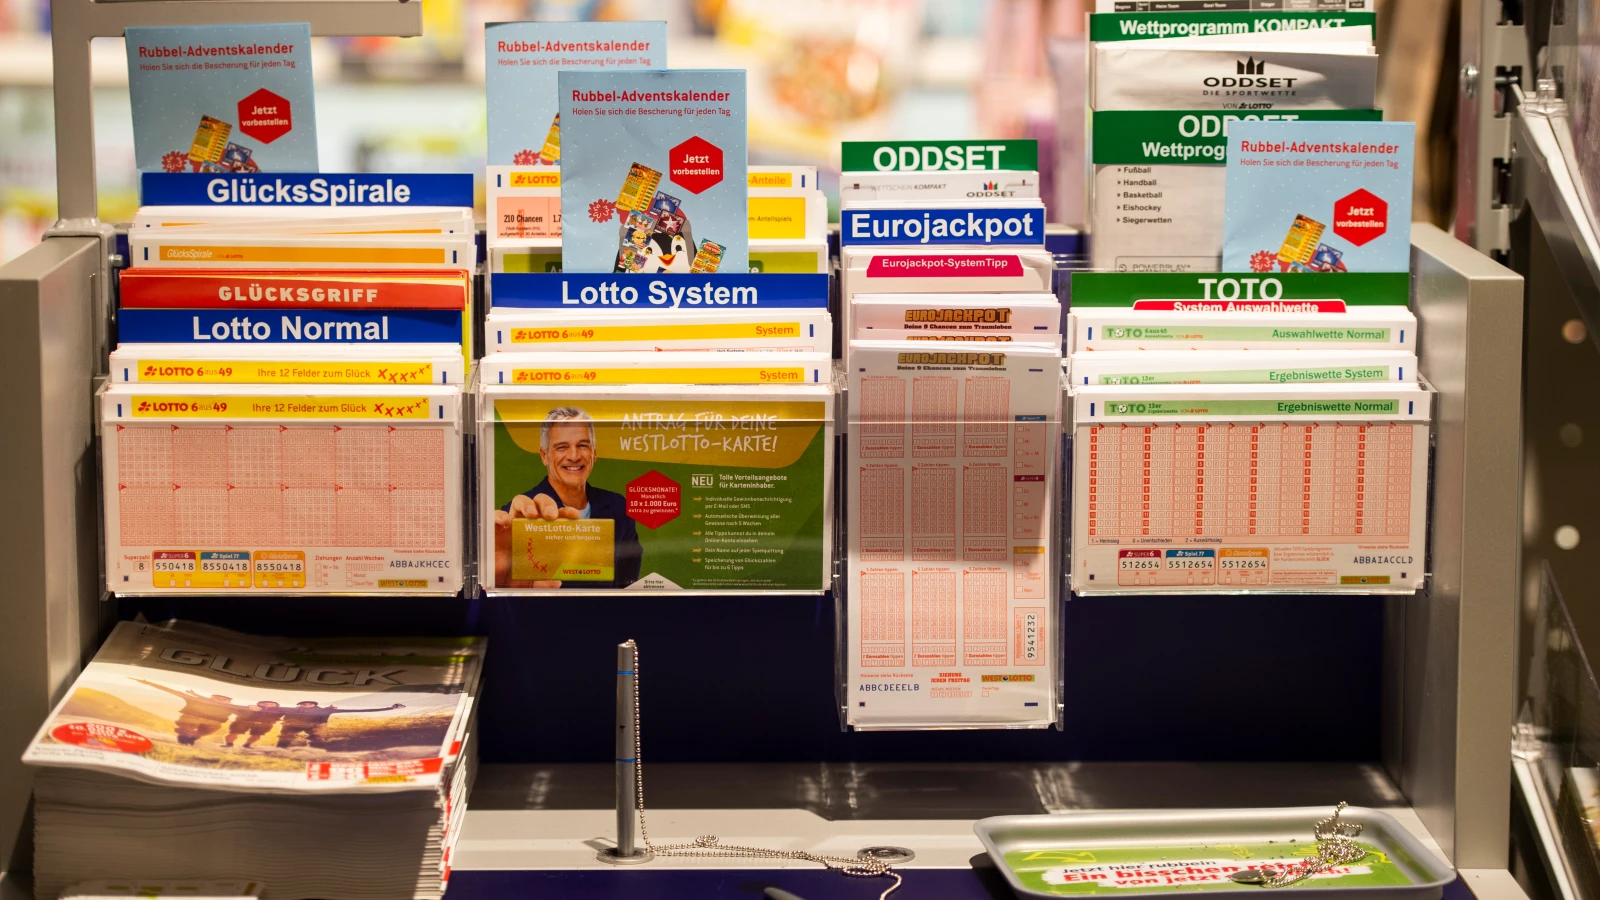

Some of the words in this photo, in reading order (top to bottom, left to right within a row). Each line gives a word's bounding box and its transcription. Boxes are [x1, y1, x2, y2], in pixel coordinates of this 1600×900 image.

[1120, 20, 1248, 38] Wettprogramm
[1254, 19, 1346, 33] KOMPAKT
[138, 43, 294, 58] Rubbel-Adventskalender
[498, 40, 651, 53] Rubbel-Adventskalender
[498, 58, 519, 66] Holen
[520, 58, 531, 66] Sie
[533, 58, 548, 66] sich
[549, 58, 561, 66] die
[562, 58, 605, 67] Bescherung
[606, 57, 616, 66] für
[618, 58, 638, 66] jeden
[639, 57, 651, 66] Tag
[1204, 77, 1298, 88] ODDSET
[572, 90, 730, 102] Rubbel-Adventskalender
[252, 106, 278, 115] Jetzt
[572, 108, 594, 116] Holen
[595, 108, 607, 116] Sie
[608, 108, 624, 116] sich
[638, 108, 683, 117] Bescherung
[696, 108, 716, 117] jeden
[718, 108, 731, 117] Tag
[242, 118, 289, 127] vorbestellen
[1142, 142, 1227, 161] Wettprog
[1241, 141, 1399, 154] Rubbel-Adventskalender
[683, 155, 710, 164] Jetzt
[873, 145, 1006, 172] ODDSET
[1306, 160, 1350, 169] Bescherung
[1364, 160, 1384, 169] jeden
[1386, 160, 1399, 170] Tag
[528, 176, 558, 184] LOTTO
[748, 176, 786, 185] -Anteile
[207, 178, 411, 206] GlücksSpirale
[1123, 204, 1162, 212] Eishockey
[1347, 207, 1374, 217] Jetzt
[504, 215, 514, 223] 210
[517, 215, 543, 223] Chancen
[1122, 217, 1172, 225] Siegerwetten
[1336, 220, 1384, 228] vorbestellen
[852, 212, 1034, 244] Eurojackpot
[167, 249, 213, 260] GlücksSpirale
[882, 258, 1008, 270] Eurojackpot-SystemTipp
[219, 284, 378, 303] GLÜCKSGRIFF
[1198, 278, 1283, 300] TOTO
[562, 281, 638, 305] Lotto
[648, 280, 758, 309] System
[1173, 302, 1222, 313] System
[1224, 302, 1319, 313] Auswahlwette
[905, 308, 1012, 323] EUROJACKPOT
[193, 316, 271, 341] Lotto
[281, 316, 389, 341] Normal
[756, 325, 794, 336] System
[1107, 328, 1143, 338] TOTO
[528, 331, 560, 340] LOTTO
[1272, 329, 1344, 340] Auswahlwette
[1346, 330, 1385, 340] Normal
[898, 353, 1007, 366] EUROJACKPOT
[159, 367, 194, 376] LOTTO
[258, 369, 276, 377] Ihre
[280, 369, 290, 377] 12
[293, 369, 320, 378] Felder
[346, 369, 371, 378] Glück
[530, 372, 562, 381] LOTTO
[760, 370, 798, 382] System
[1269, 371, 1342, 383] Ergebniswette
[1344, 369, 1384, 380] System
[153, 403, 188, 412] LOTTO
[253, 404, 271, 412] Ihre
[275, 404, 285, 412] 12
[288, 404, 315, 413] Felder
[341, 404, 367, 413] Glück
[1110, 404, 1146, 414] TOTO
[1277, 402, 1351, 414] Ergebniswette
[1356, 402, 1393, 411] Normal
[621, 413, 685, 432] ANTRAG
[695, 412, 726, 433] FÜR
[731, 414, 778, 432] DEINE
[620, 434, 778, 453] WESTLOTTO-KARTE!
[692, 476, 713, 486] NEU
[734, 474, 788, 482] Vorteilsangebote
[525, 524, 601, 533] WestLotto-Karte
[390, 560, 450, 569] ABBAJKHCEC
[1122, 561, 1160, 569] 512654
[1168, 561, 1213, 569] 5512654
[1222, 561, 1266, 569] 5512654
[1354, 556, 1414, 564] ABBAIACCLD
[156, 562, 194, 571] 550418
[202, 562, 248, 571] 8550418
[257, 562, 301, 571] 8550418
[1028, 614, 1036, 659] 9541232
[160, 647, 407, 687] GLÜCK
[860, 684, 920, 692] ABBCDEEELB
[1149, 860, 1217, 869] rubbeln
[1064, 873, 1108, 882] Ein
[1115, 866, 1240, 879] bisschen
[1166, 874, 1221, 885] jetzt
